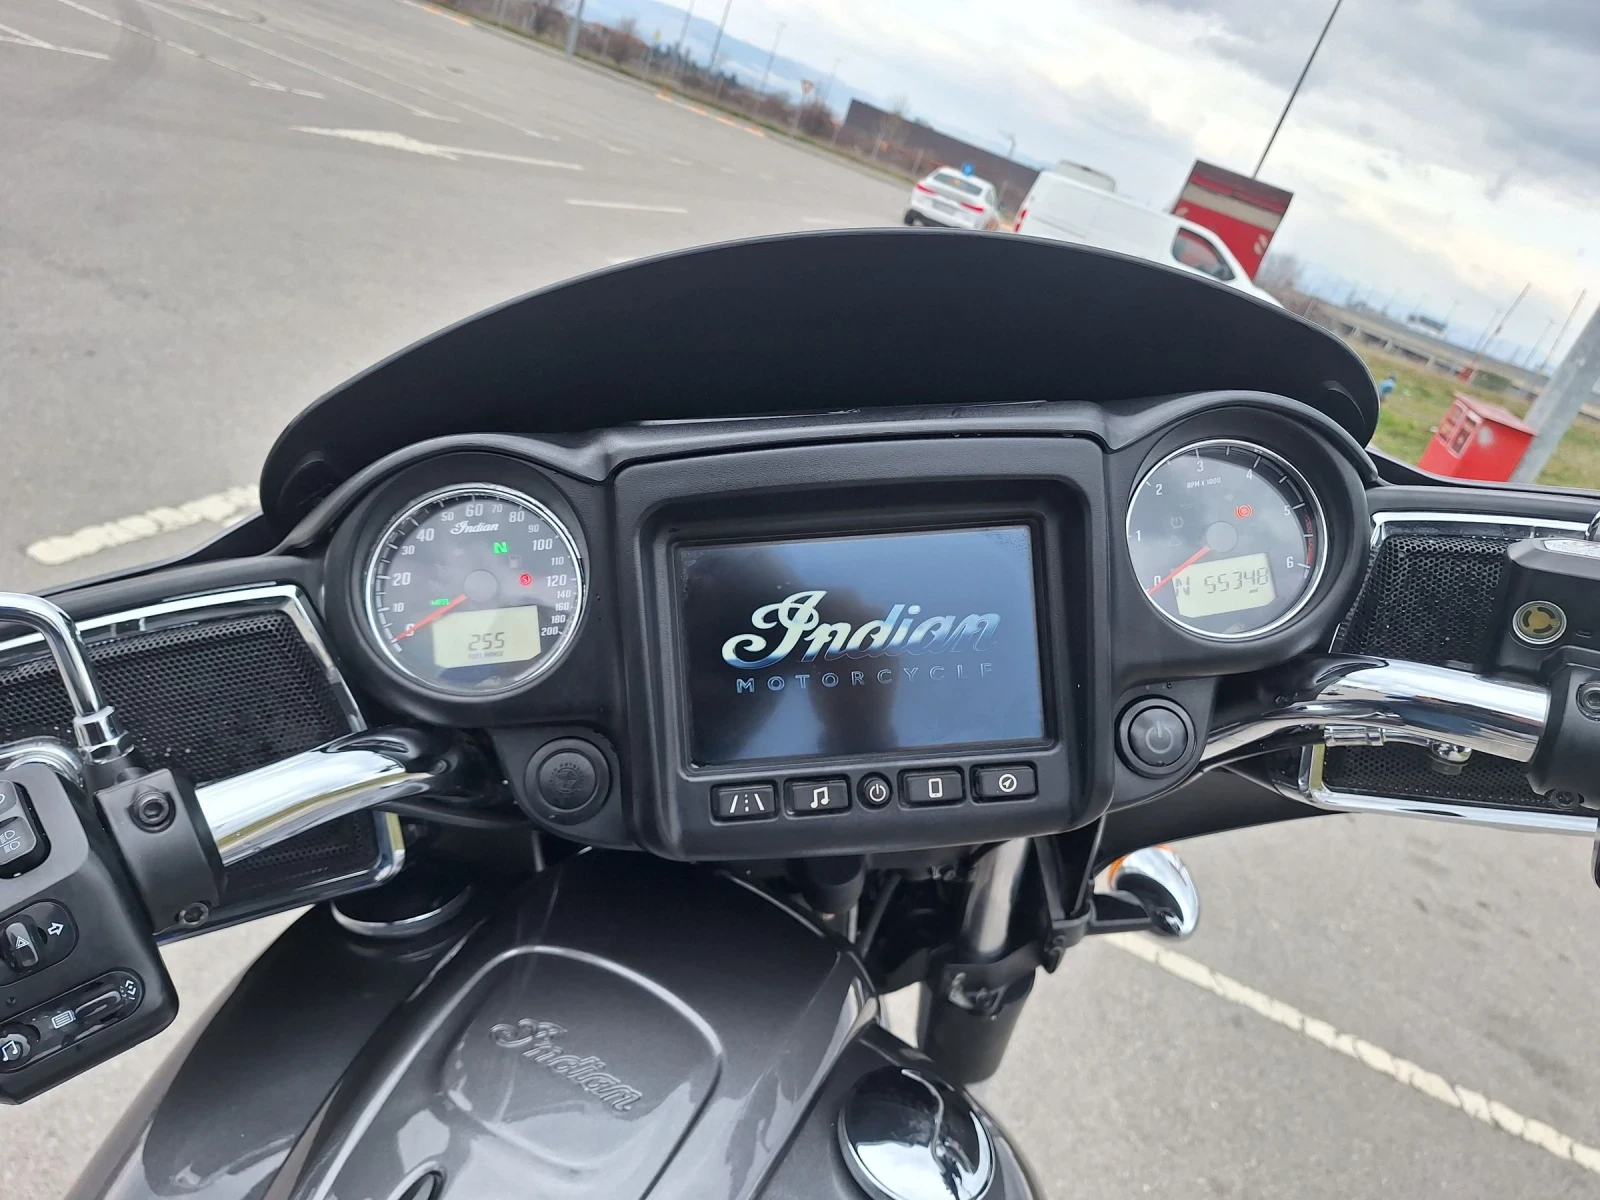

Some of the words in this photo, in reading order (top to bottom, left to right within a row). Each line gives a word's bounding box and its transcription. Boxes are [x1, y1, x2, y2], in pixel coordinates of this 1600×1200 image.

[1197, 461, 1204, 472] 3
[1246, 469, 1253, 480] 4
[1156, 484, 1163, 496] 2
[466, 504, 484, 517] 60
[492, 504, 503, 513] 70
[1285, 505, 1291, 516] 5
[442, 512, 455, 521] 50
[509, 511, 525, 523] 80
[451, 521, 500, 535] Indian
[528, 525, 540, 533] 90
[416, 528, 435, 541] 40
[1136, 530, 1141, 541] 1
[402, 545, 415, 556] 30
[494, 542, 508, 554] N
[533, 539, 553, 551] 100
[551, 557, 564, 566] 110
[1287, 557, 1294, 569] 6
[393, 572, 411, 587] 20
[547, 575, 567, 587] 120
[1175, 576, 1190, 597] N
[1204, 567, 1268, 594] 55348
[557, 590, 571, 599] 140
[394, 602, 404, 612] 10
[555, 602, 569, 612] 160
[551, 614, 566, 624] 180
[541, 626, 559, 636] 200
[721, 590, 1002, 669] Indian
[468, 632, 505, 651] 255
[490, 1017, 643, 1111] Indian
